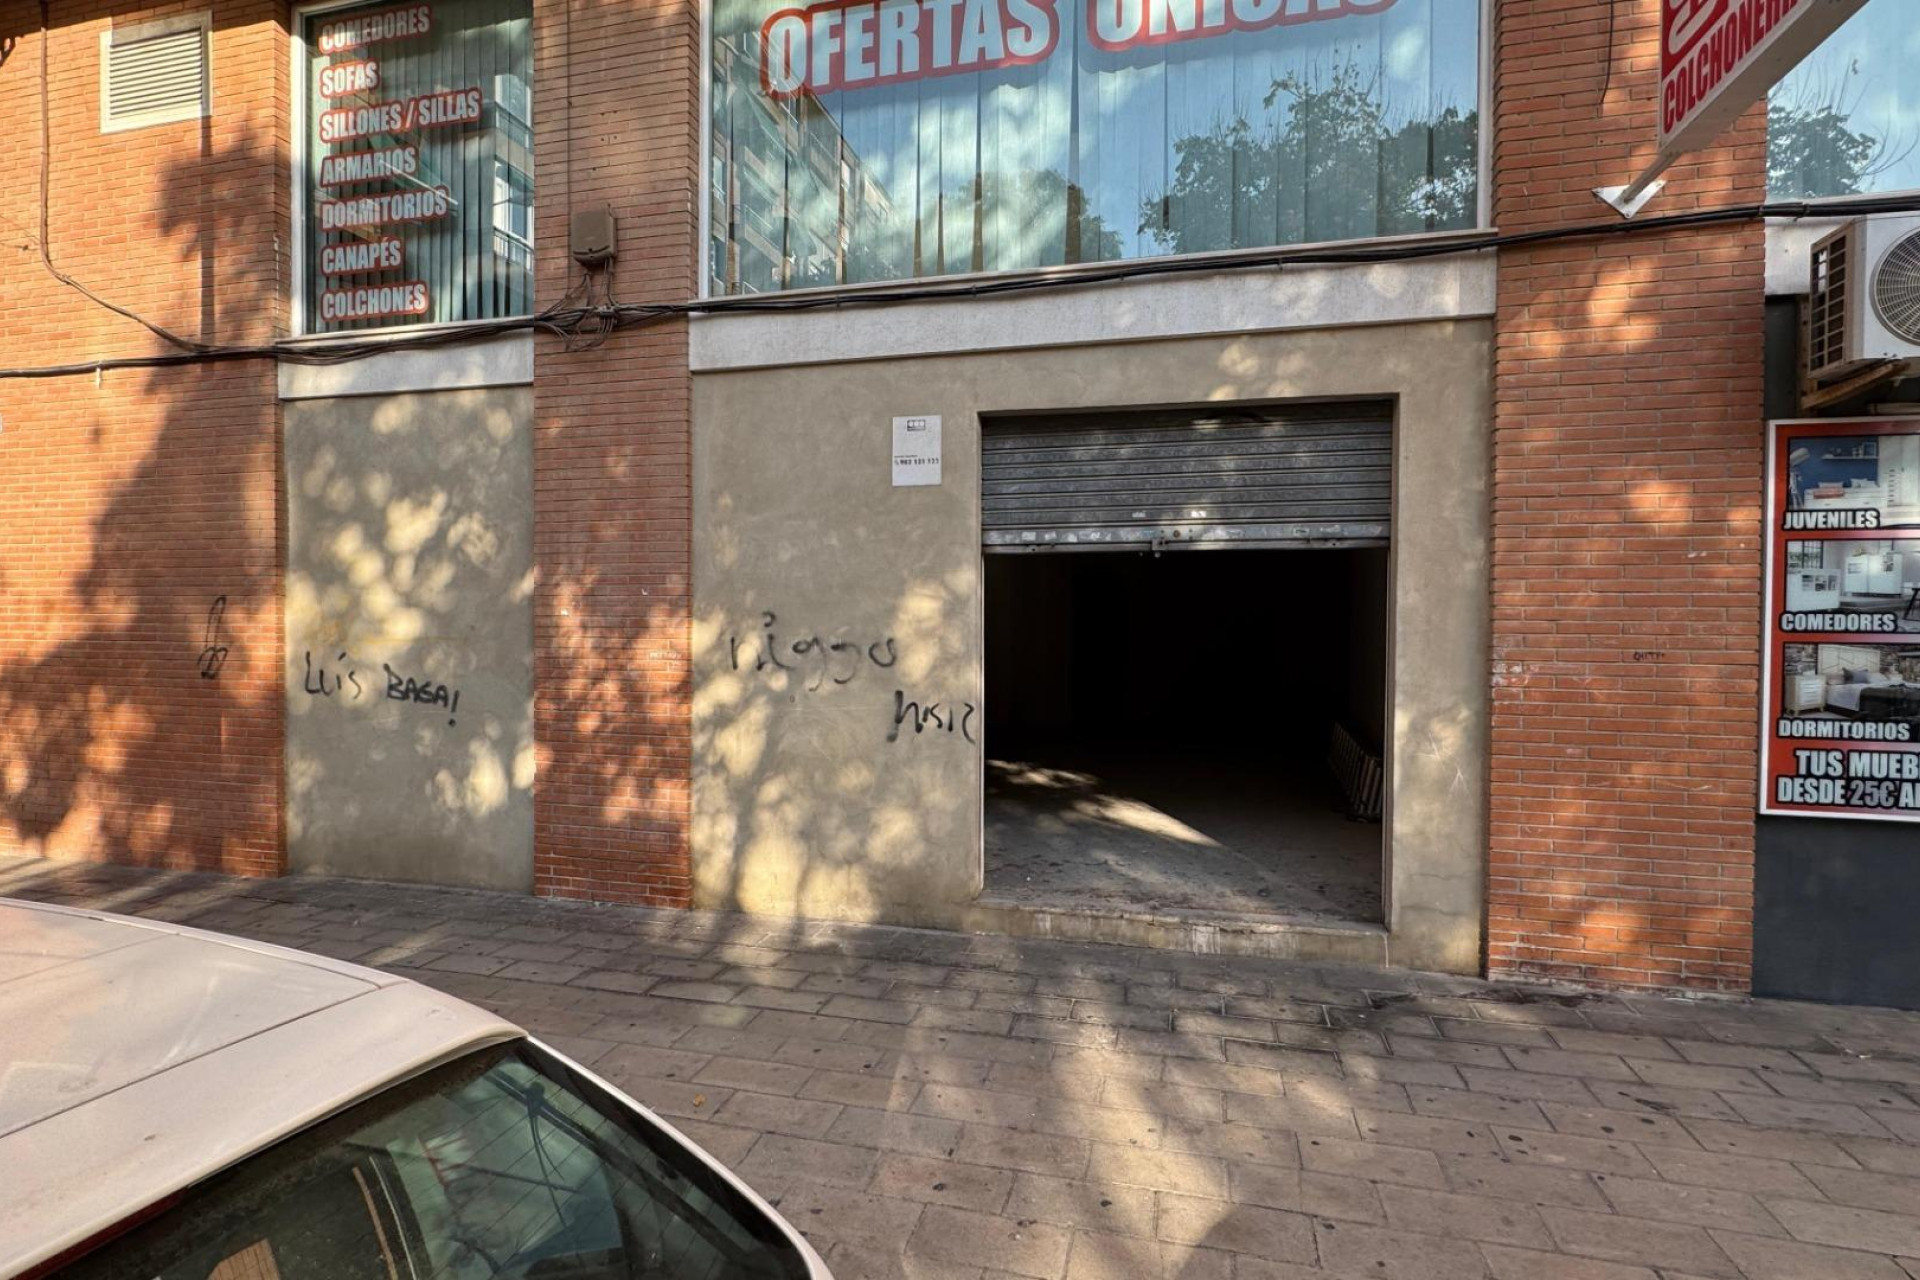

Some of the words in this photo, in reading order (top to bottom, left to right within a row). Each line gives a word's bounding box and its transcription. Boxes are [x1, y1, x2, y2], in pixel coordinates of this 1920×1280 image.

[322, 6, 430, 50] COMEDORES
[768, 0, 1050, 92] OFERTAS
[322, 61, 377, 95] SOFAS
[322, 148, 416, 185] ARMARIOS
[322, 190, 447, 229] DORMITORIOS
[322, 284, 426, 318] COLCHONES
[1784, 510, 1878, 529] JUVENILES
[1781, 613, 1895, 631] COMEDORES
[1779, 720, 1910, 741] DORMITORIOS
[1796, 749, 1843, 777] TUS
[1849, 751, 1920, 779] MUEB
[1777, 776, 1846, 804] DESDE
